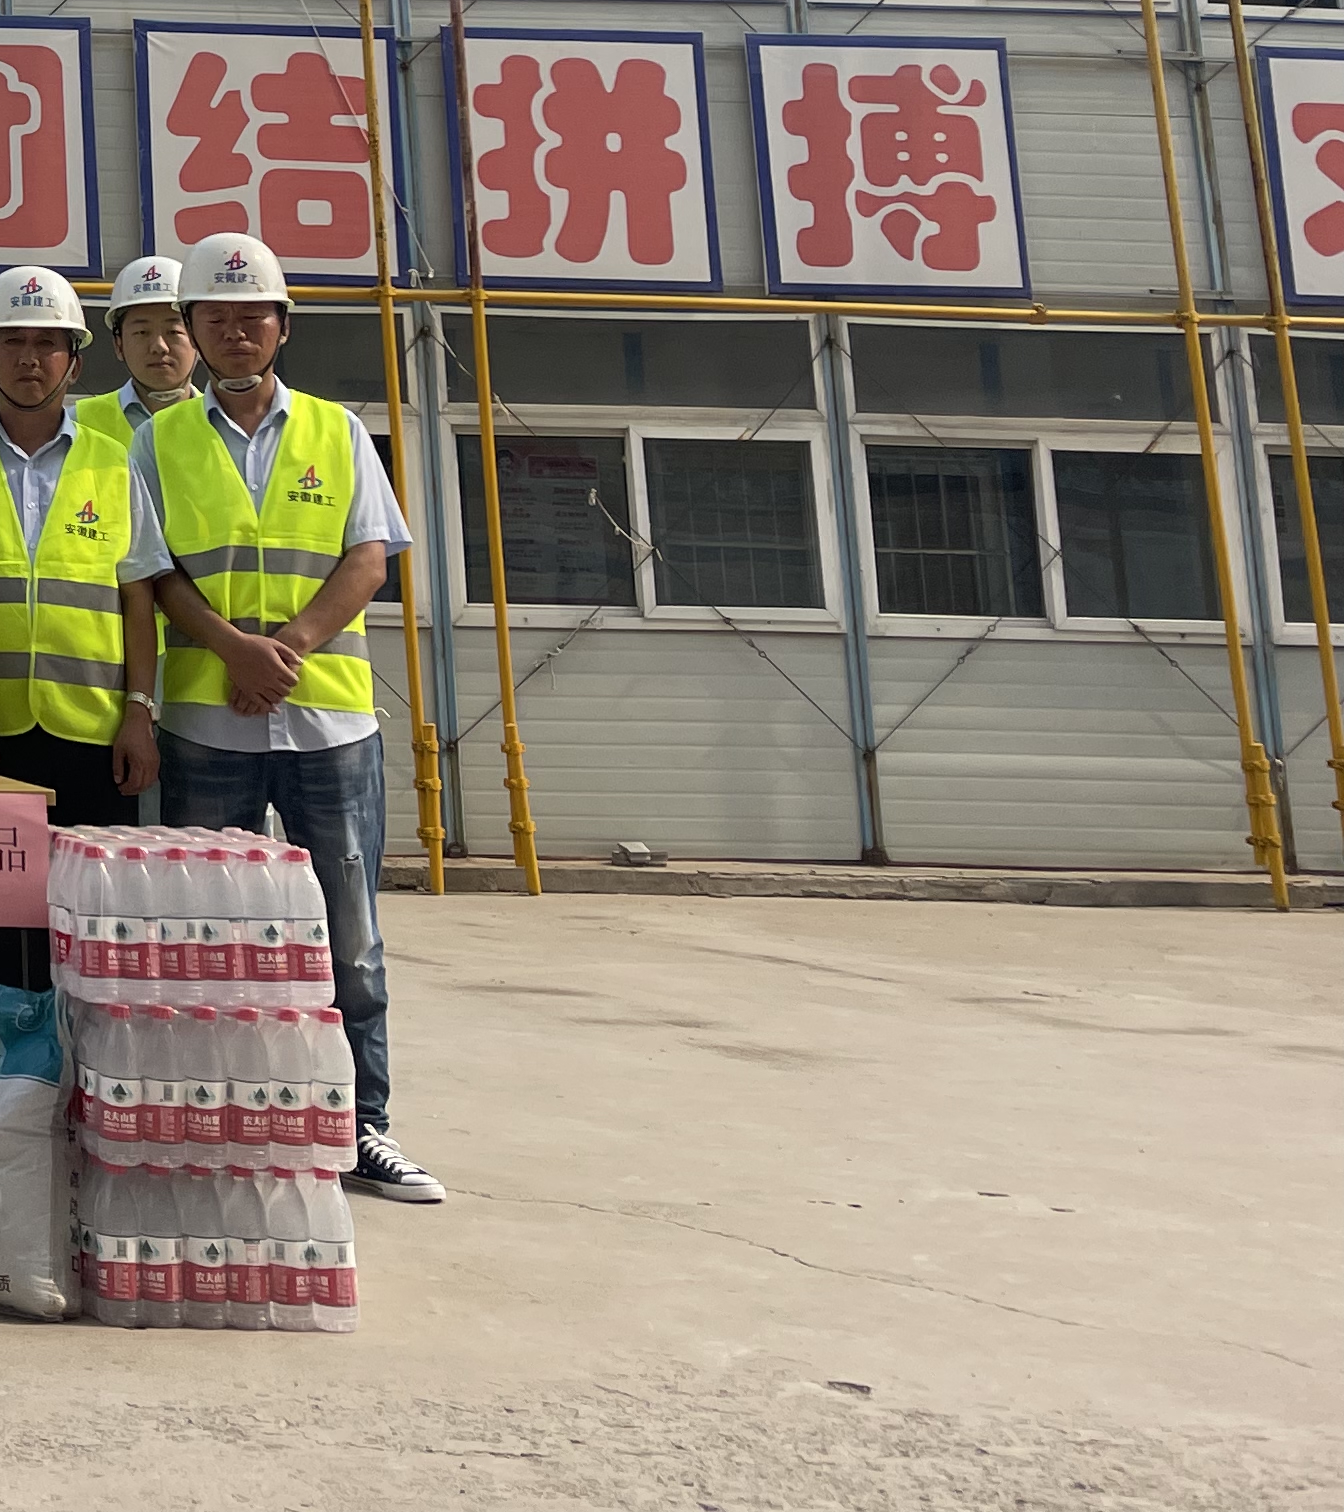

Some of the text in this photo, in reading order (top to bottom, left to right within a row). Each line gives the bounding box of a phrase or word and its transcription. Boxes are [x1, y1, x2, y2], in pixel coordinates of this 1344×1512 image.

[214, 273, 257, 286] 安徽建工
[133, 282, 173, 294] 安徽建工
[10, 294, 56, 309] 安徽建工
[287, 490, 337, 508] 安徽建工
[64, 522, 111, 543] 安徽建工
